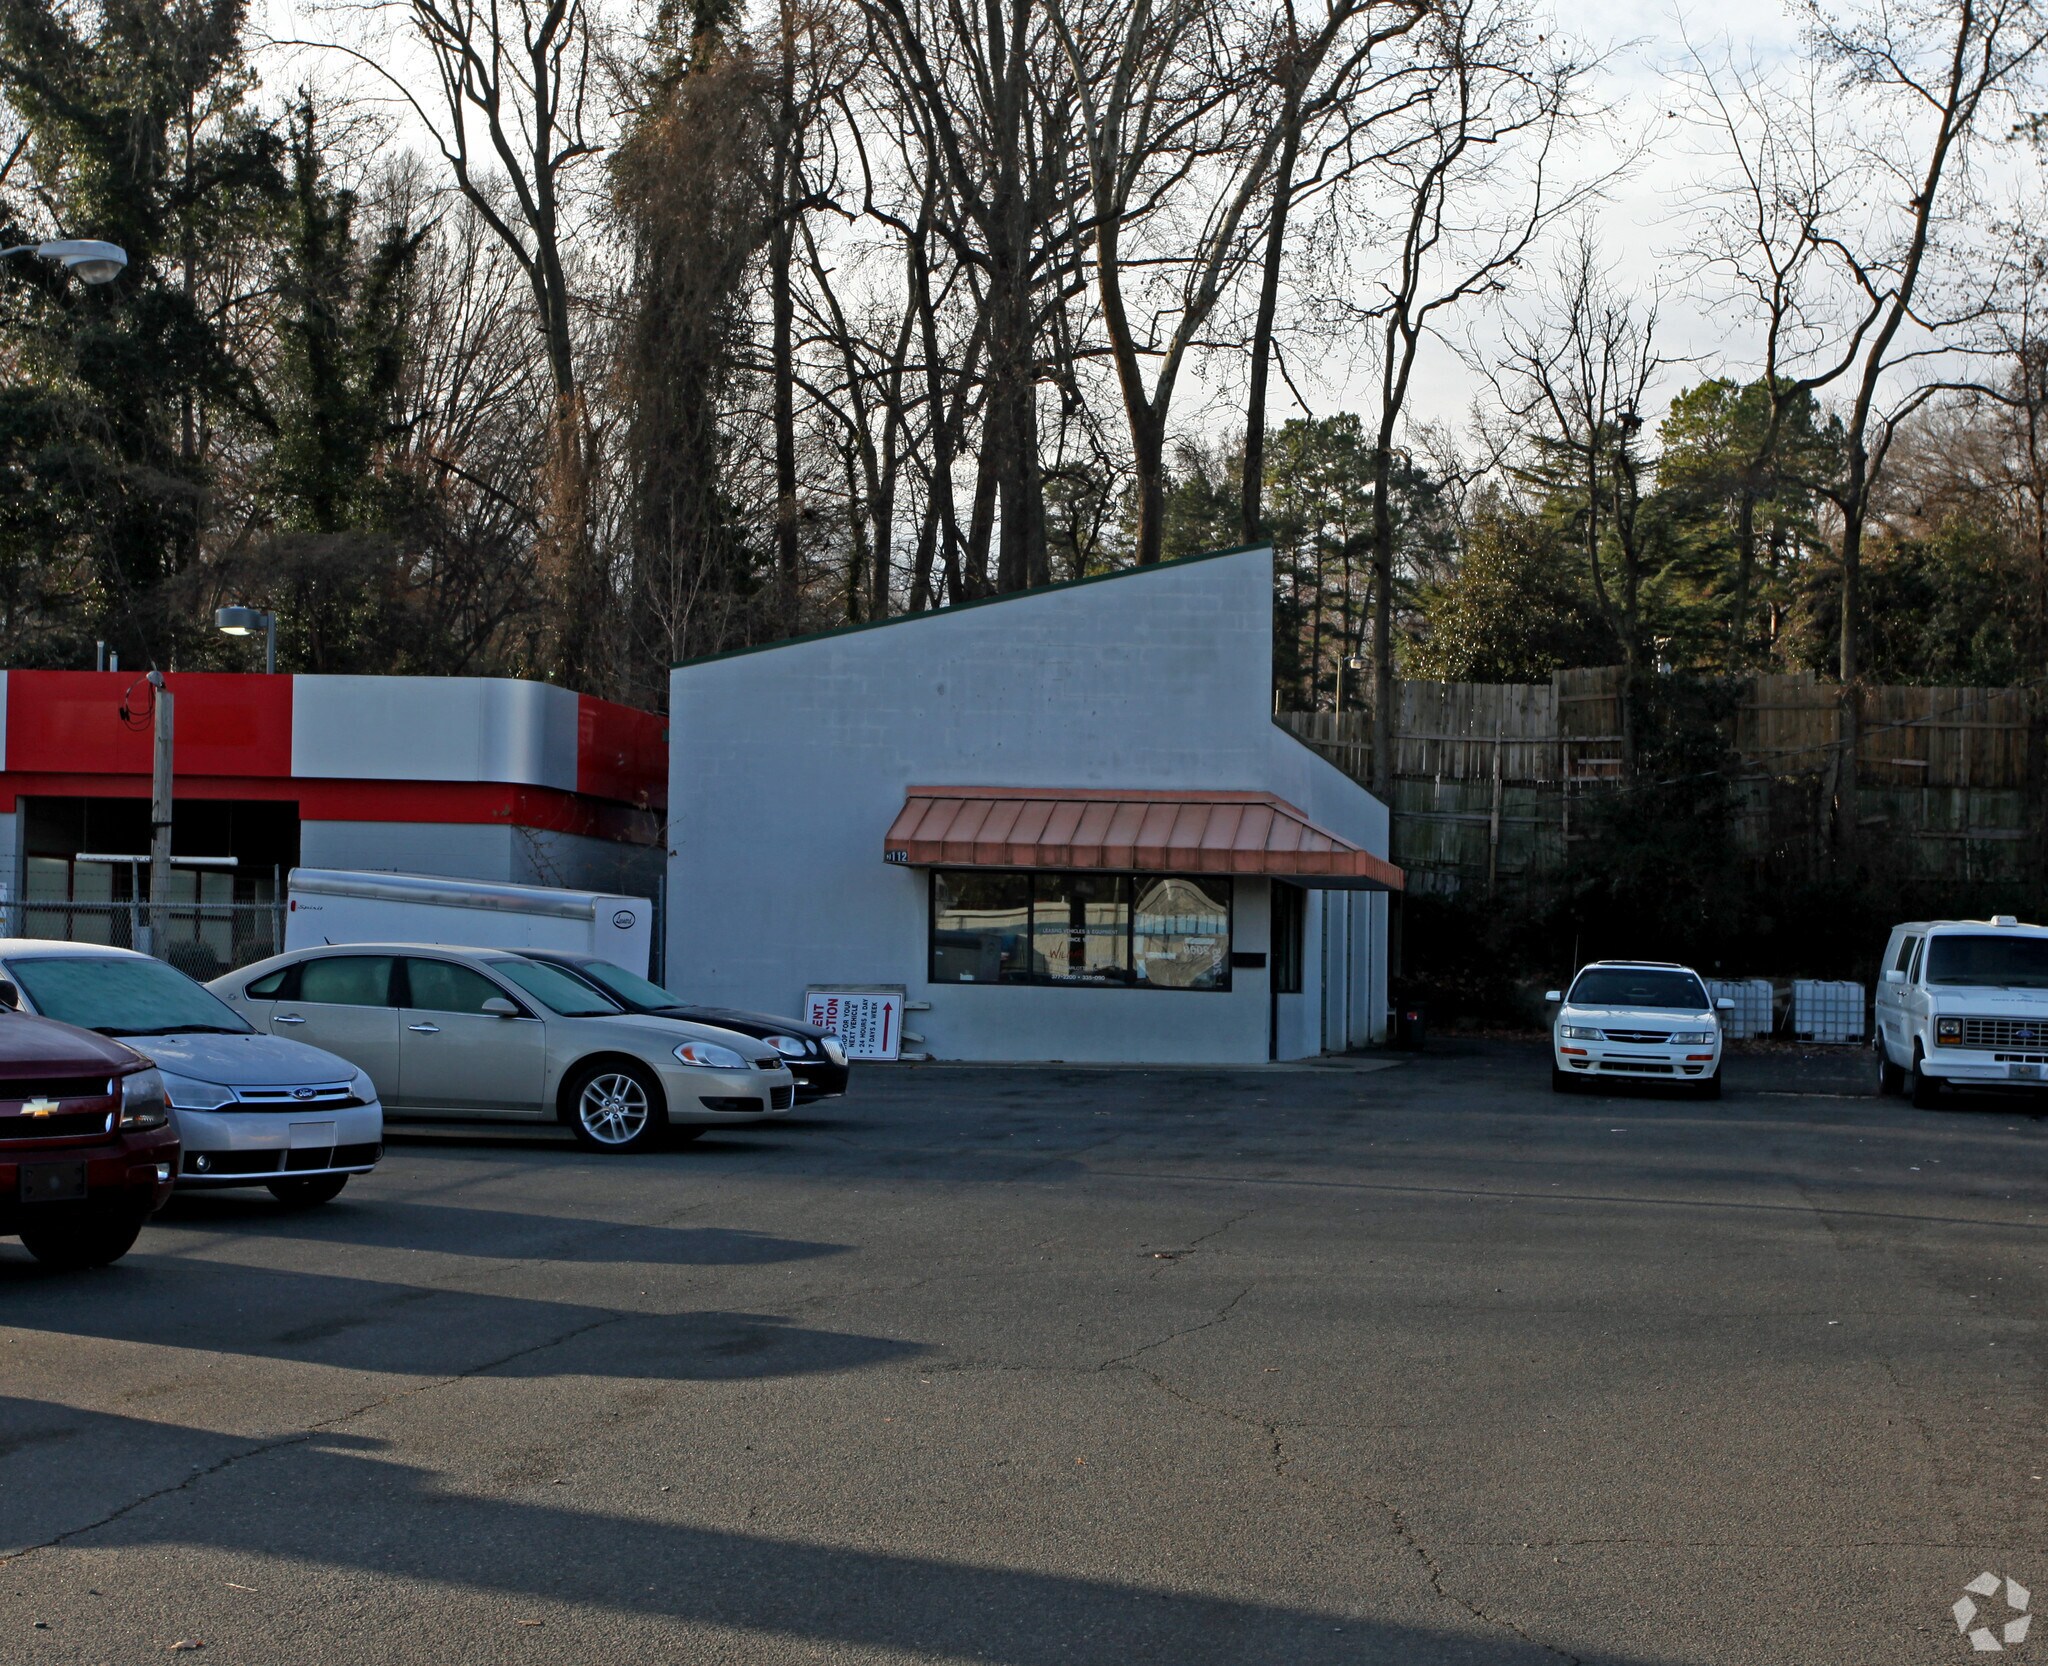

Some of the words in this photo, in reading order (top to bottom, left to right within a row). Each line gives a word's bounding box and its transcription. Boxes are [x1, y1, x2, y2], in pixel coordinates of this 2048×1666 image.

[826, 998, 839, 1034] CTION
[843, 1000, 851, 1017] YOUR
[850, 1004, 858, 1029] VEHICLE
[870, 1002, 878, 1019] WEEK
[859, 1040, 865, 1048] 24
